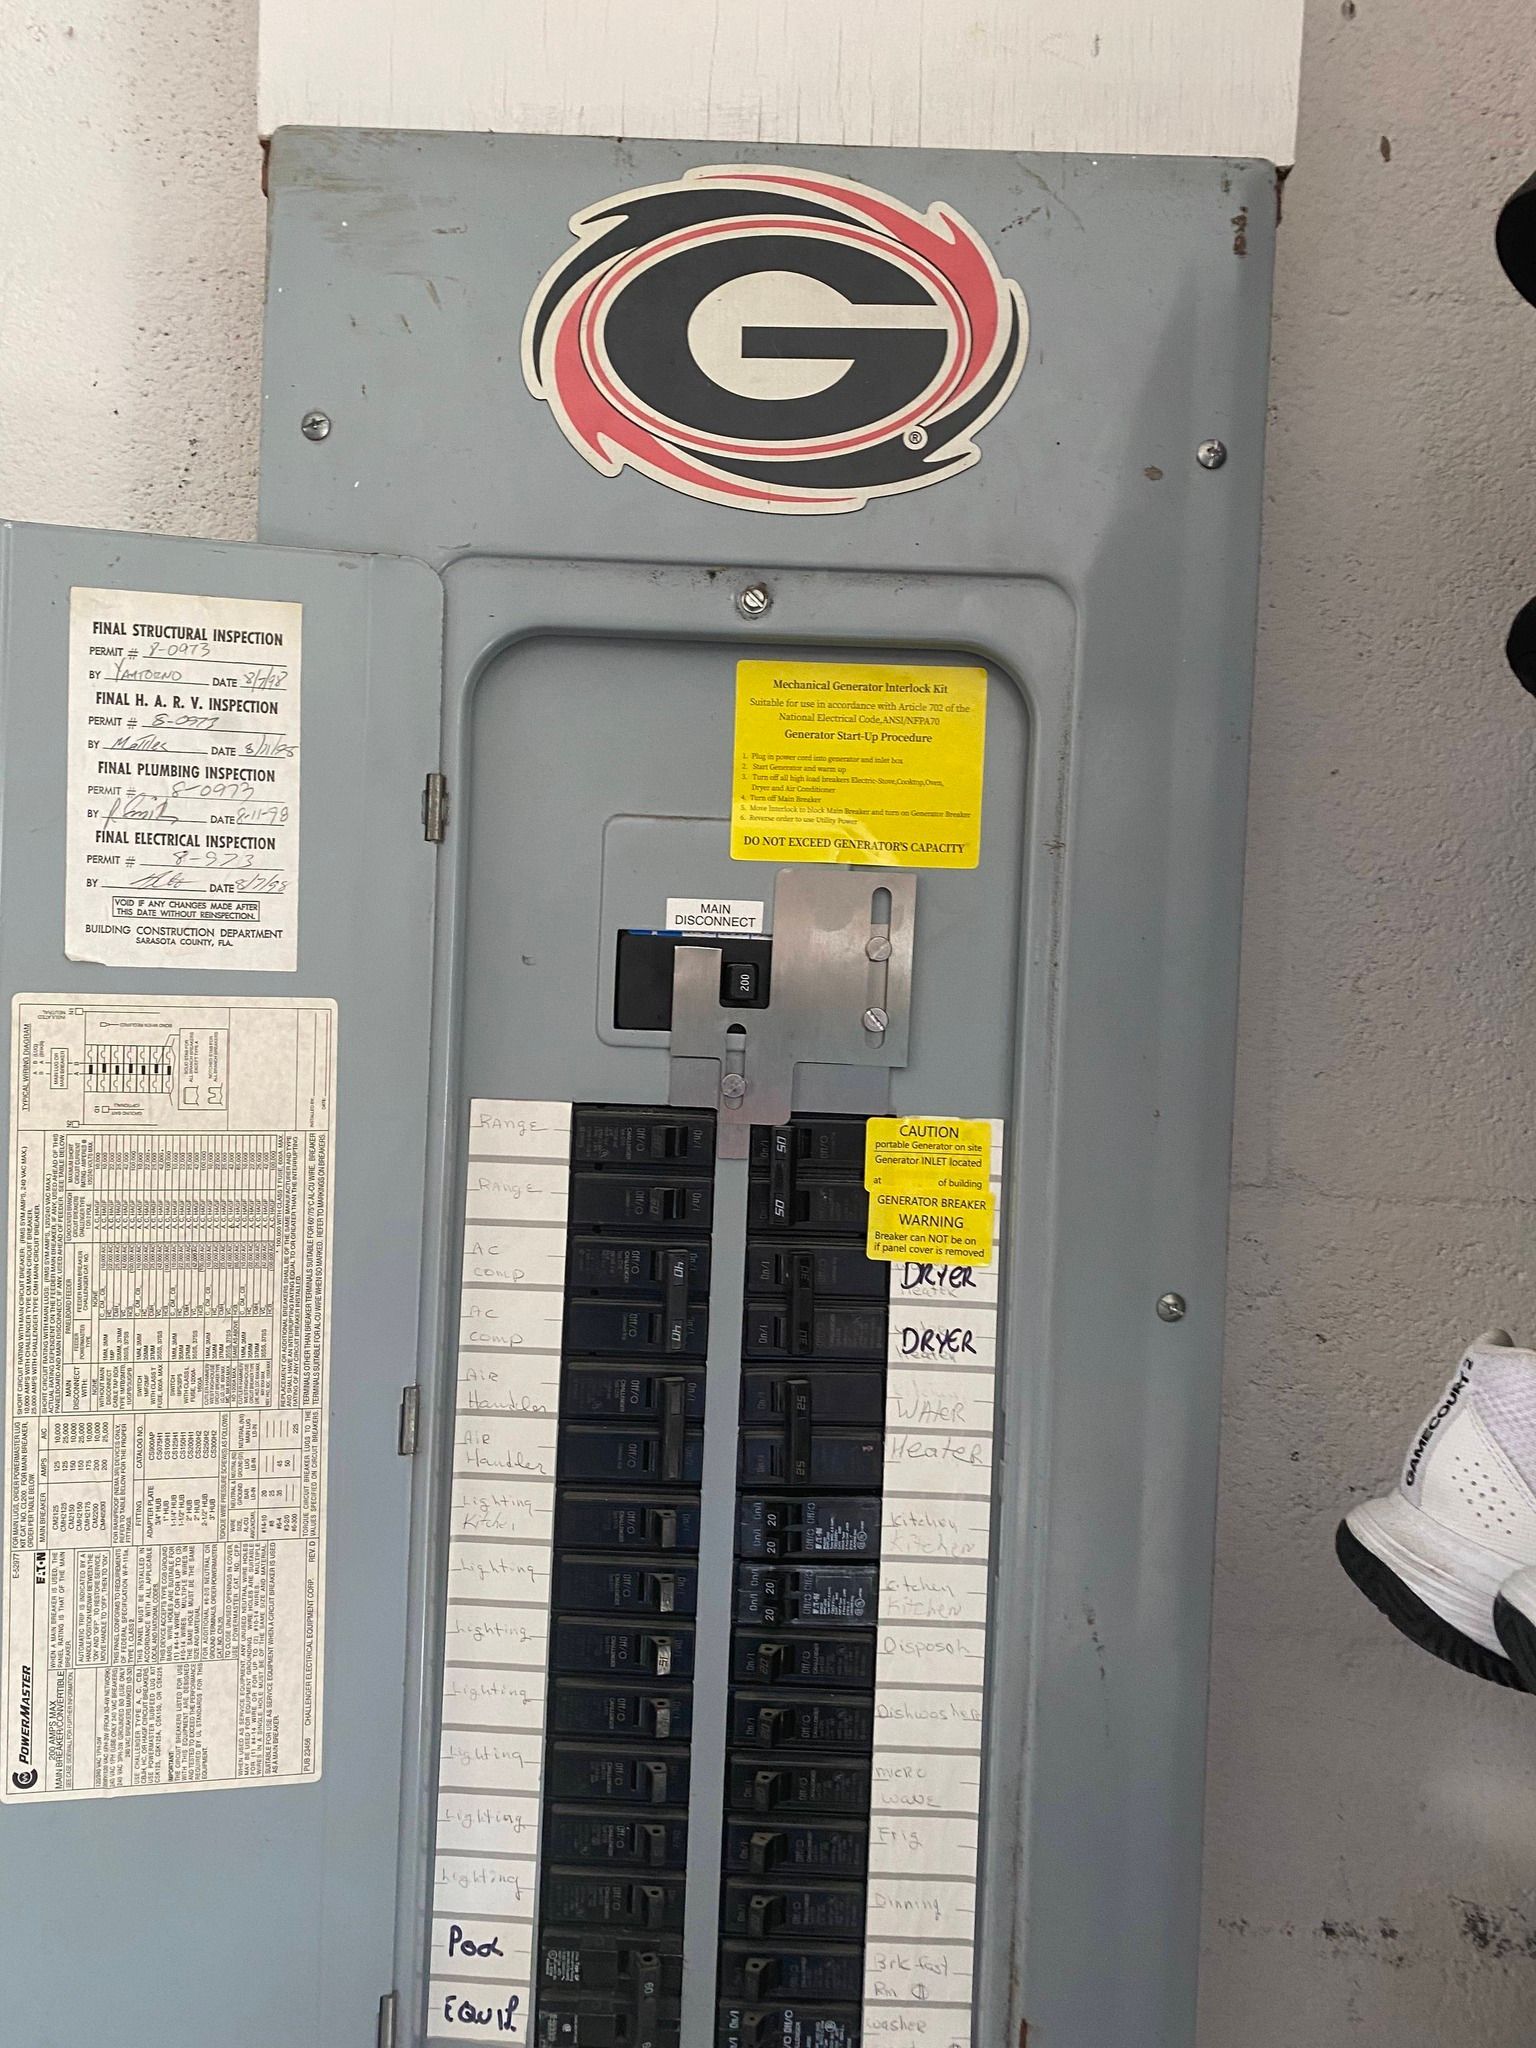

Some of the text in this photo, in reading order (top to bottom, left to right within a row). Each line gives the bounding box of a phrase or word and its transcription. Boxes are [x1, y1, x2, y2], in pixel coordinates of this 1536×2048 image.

[603, 235, 948, 441] G
[93, 622, 283, 646] FINAL STRUCTURAL INSPECTION
[89, 647, 123, 657] PERMIT
[128, 648, 138, 660] #
[89, 671, 101, 679] BY
[212, 678, 237, 687] DATE
[773, 679, 948, 694] Mechanical Generator Interlock Kit
[96, 692, 278, 714] FINAL H. A. R. V. INSPECTION
[750, 697, 784, 708] Suitable
[786, 699, 798, 708] for
[817, 700, 826, 709] in
[827, 701, 876, 711] accordance
[877, 702, 896, 711] with
[898, 703, 927, 712] Article
[929, 704, 943, 712] 702
[945, 704, 956, 712] of
[957, 705, 970, 713] the
[88, 716, 138, 729] PERMIT #
[779, 712, 815, 722] National
[817, 714, 857, 723] Electrical
[784, 729, 932, 743] Generator Start-Up Procedure
[88, 740, 236, 756] BY DATE
[98, 761, 275, 782] FINAL PLUMBING INSPECTION
[88, 786, 122, 795] PERMIT
[126, 786, 136, 798] #
[87, 809, 235, 824] BY DATE
[95, 831, 275, 850] FINAL ELECTRICAL INSPECTION
[744, 836, 966, 853] DO NOT EXCEED GENERATOR'S CAPACITY
[86, 854, 121, 865] PERMIT
[125, 855, 136, 868] #
[86, 878, 235, 893] BY DATE
[114, 898, 134, 906] VOID
[169, 901, 206, 909] CHANGES
[210, 902, 232, 910] MADE
[236, 903, 258, 911] AFTER
[700, 903, 731, 914] MAIN
[160, 910, 196, 918] WITHOUT
[200, 911, 255, 920] REINSPECTION.
[675, 915, 756, 927] DISCONNECT
[85, 924, 283, 938] BUILDING CONSTRUCTION DEPARTMENT
[135, 937, 234, 947] SARASOTA COUNTY, FLA.
[740, 974, 750, 991] 200
[21, 1023, 31, 1111] TYPICAL WIRING DIAGRAM
[900, 1125, 959, 1138] CAUTION
[776, 1136, 787, 1153] 50
[875, 1141, 910, 1149] portable
[912, 1141, 953, 1150] Generator
[875, 1155, 982, 1168] Generator INLET located
[948, 1180, 982, 1190] building
[775, 1199, 785, 1217] 50
[877, 1195, 986, 1210] GENERATOR BREAKER
[899, 1214, 964, 1229] WARNING
[874, 1231, 910, 1241] Breaker
[929, 1234, 948, 1243] NOT
[951, 1236, 962, 1244] be
[873, 1242, 880, 1250] if
[882, 1244, 907, 1254] panel
[936, 1246, 943, 1254] is
[945, 1249, 984, 1257] removed
[902, 1327, 976, 1354] DRYER
[1406, 1358, 1474, 1486] GAMECOURT 2
[767, 1513, 777, 1527] 20
[766, 1541, 776, 1554] 20
[765, 1582, 775, 1595] 20
[764, 1609, 774, 1622] 20
[305, 1578, 316, 1726] CHALLENGER ELECTRICAL EQUIPMENT CORP.
[48, 1700, 57, 1761] 200 AMPS MAX
[56, 1671, 65, 1789] MAIN BREAKER/CONVERTIBLE
[303, 1737, 312, 1772] PUB 23456
